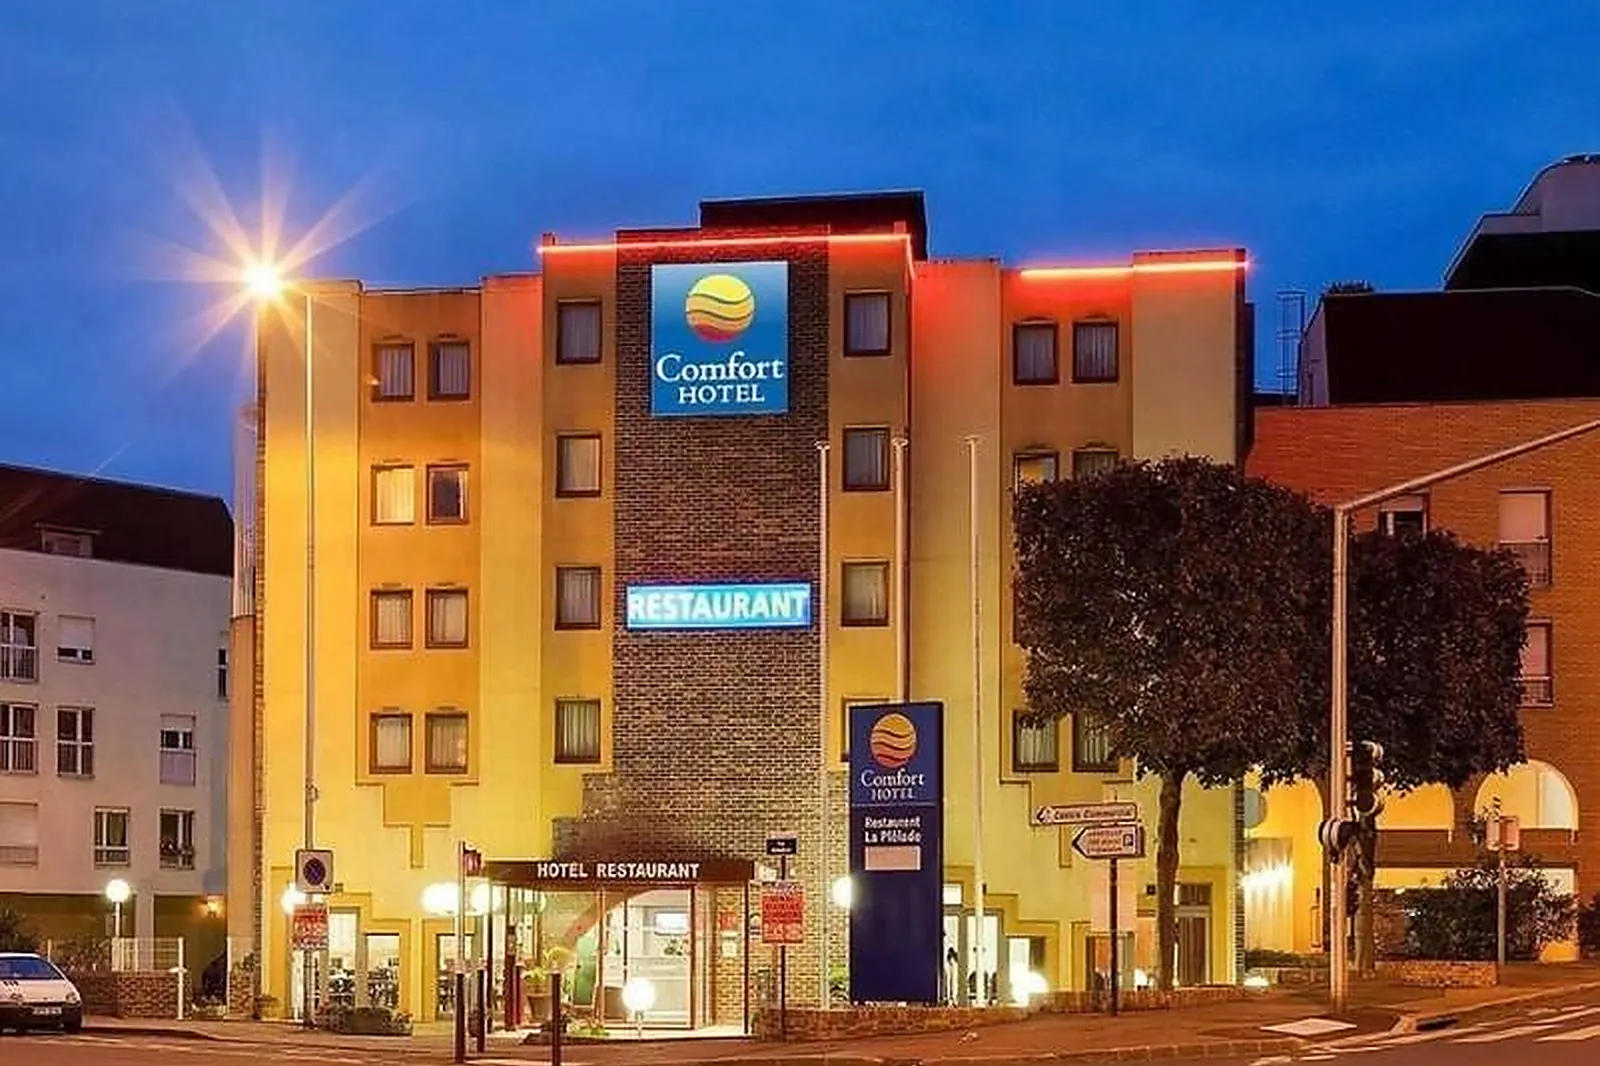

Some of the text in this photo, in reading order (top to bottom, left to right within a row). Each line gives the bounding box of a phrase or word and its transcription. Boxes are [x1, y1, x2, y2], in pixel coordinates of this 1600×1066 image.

[656, 351, 784, 382] Comfort
[678, 384, 765, 404] HOTEL
[628, 591, 808, 620] RESTAURANT
[861, 767, 925, 787] Comfort
[870, 787, 915, 800] HOTEL
[864, 831, 878, 843] La
[537, 862, 700, 878] HOTEL RESTAURANT
